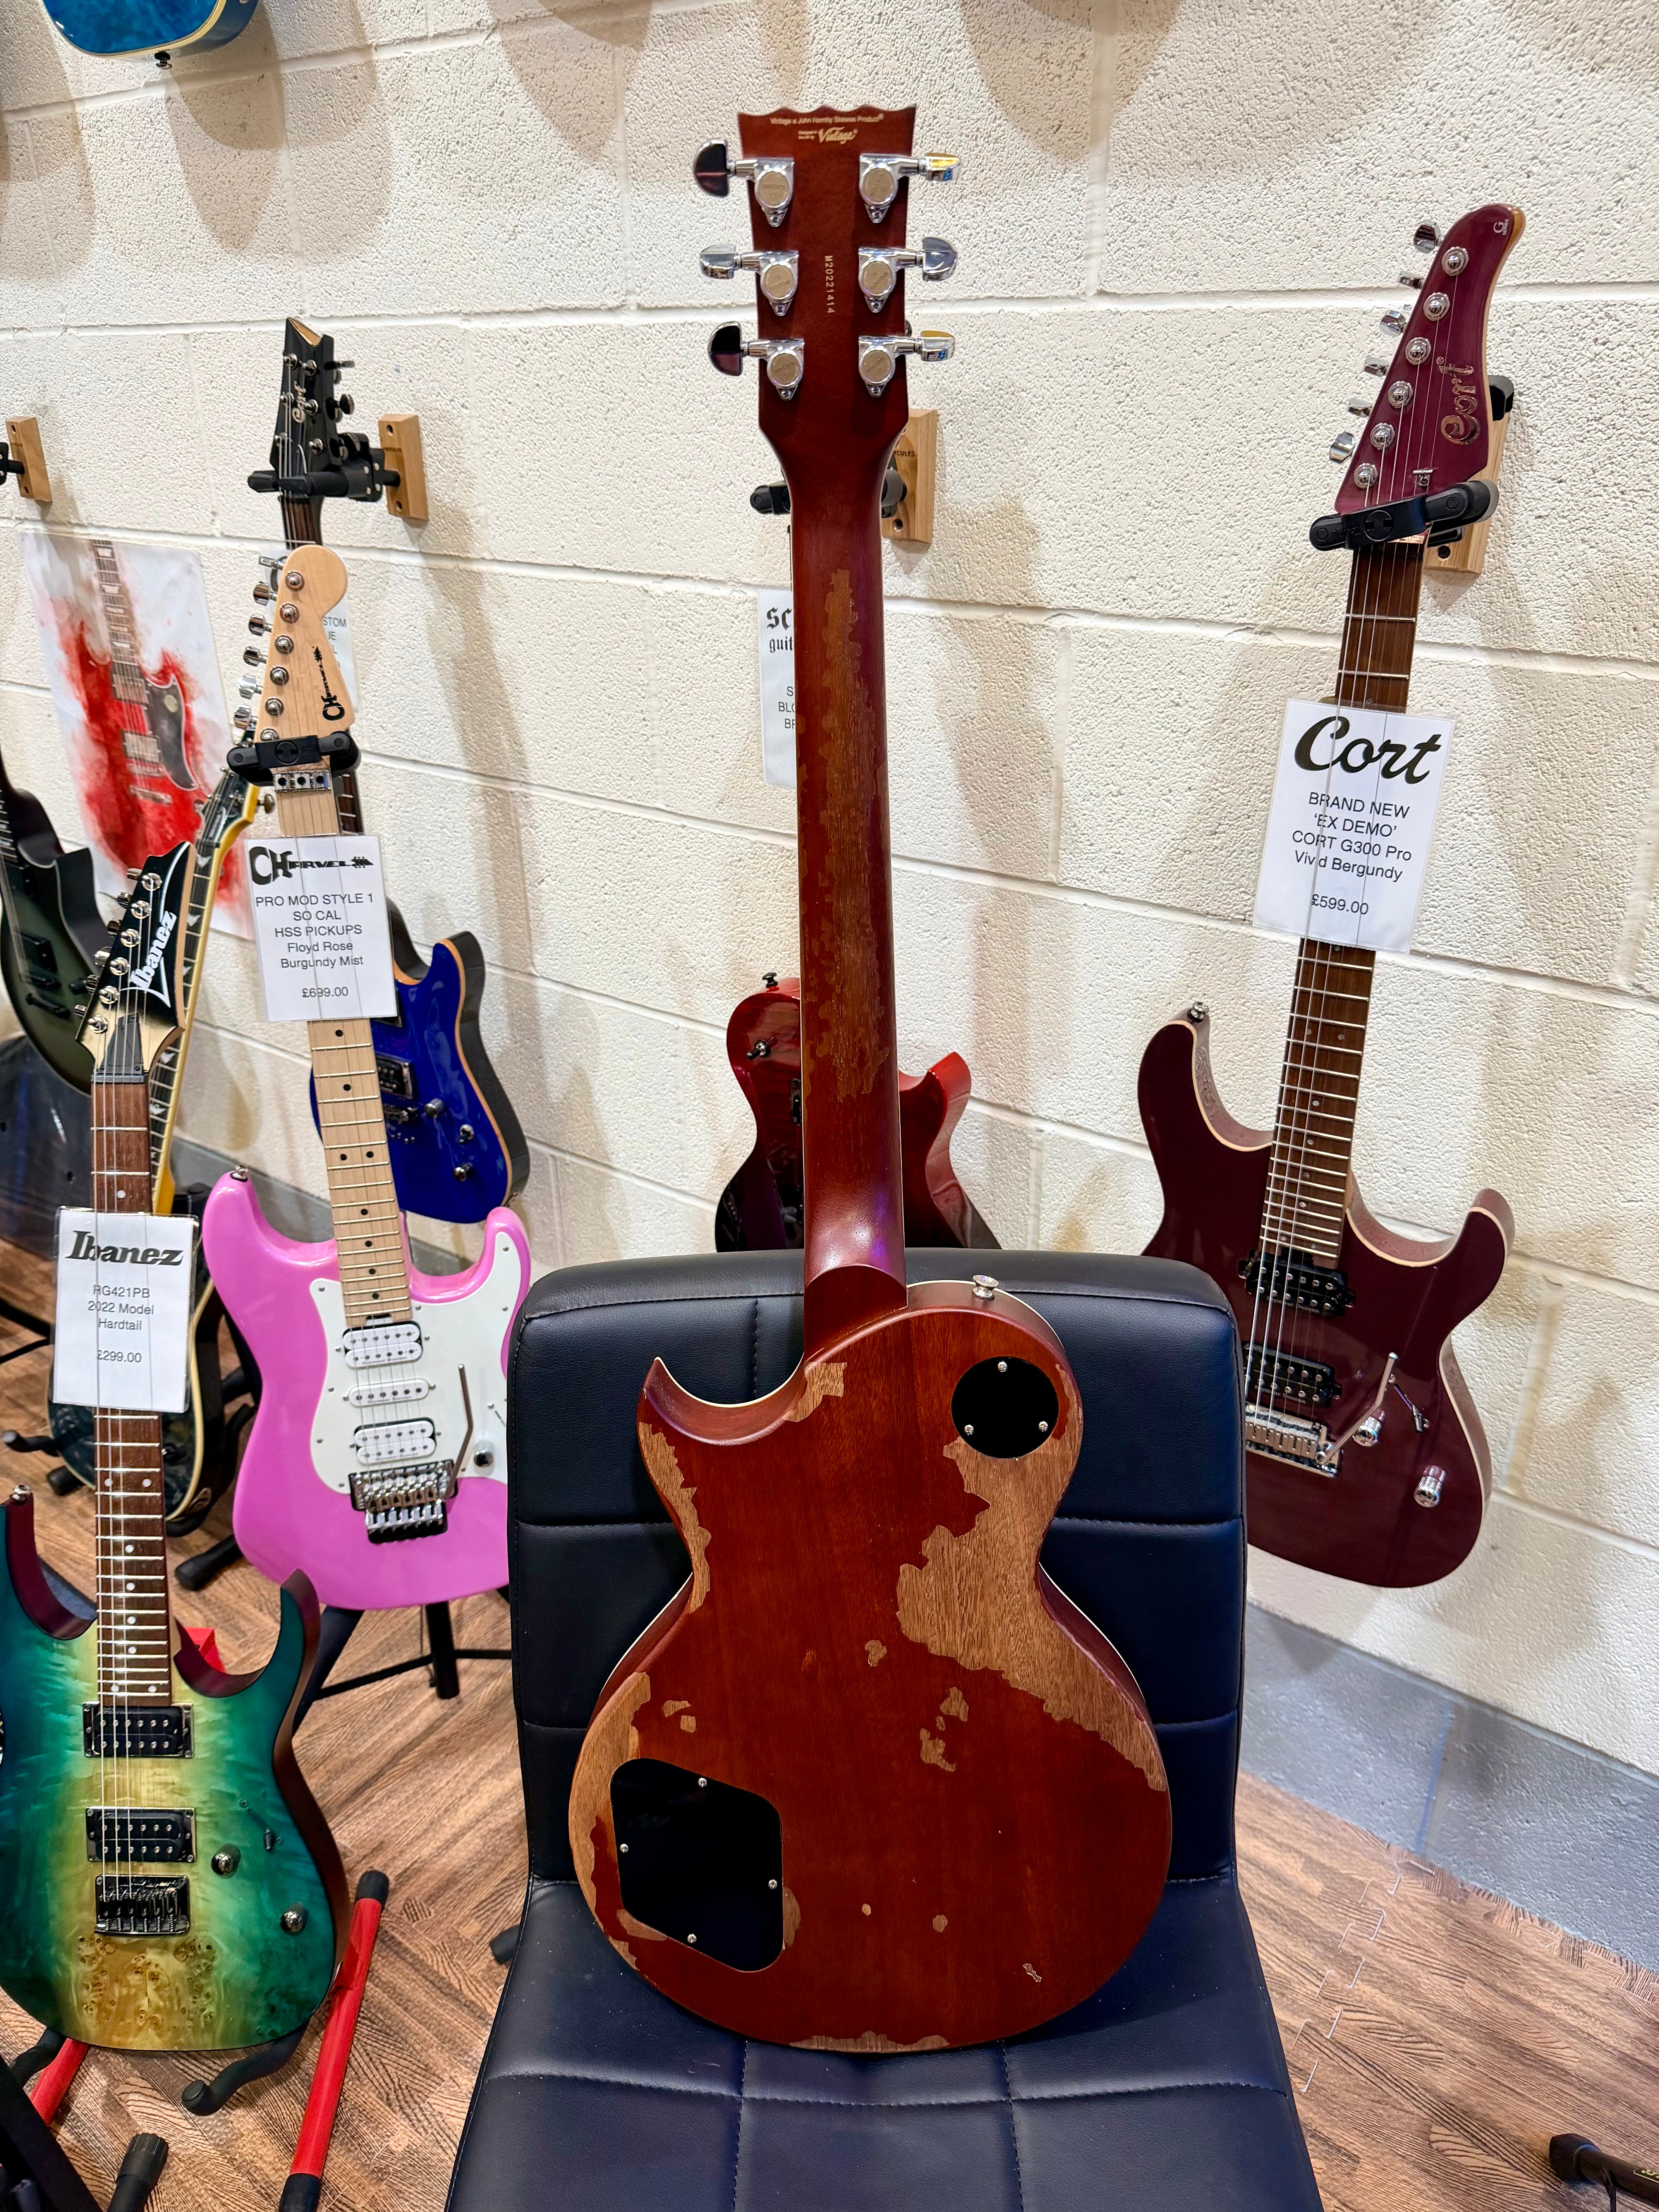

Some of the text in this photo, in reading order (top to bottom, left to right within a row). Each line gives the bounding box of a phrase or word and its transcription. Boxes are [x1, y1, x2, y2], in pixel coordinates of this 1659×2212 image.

[825, 255, 835, 313] M20221414
[322, 617, 347, 628] STOM
[1294, 716, 1442, 785] Cort
[1309, 792, 1410, 819] BRAND NEW
[1292, 830, 1412, 861] CORT G300 Pro
[1295, 850, 1403, 883] Vivd Bergundy
[256, 893, 373, 907] PRO MOD STYLE 1
[1310, 893, 1369, 915] £599.00
[293, 910, 342, 921] SO CAL
[275, 924, 362, 938] HSS PICKUPS
[129, 910, 177, 989] Ibanez
[288, 941, 353, 955] Floyd Rose
[281, 955, 364, 970] Burgundy Mist
[302, 986, 349, 998] £699.00
[65, 1230, 184, 1266] Ibanez
[93, 1284, 150, 1298] RG421PB
[88, 1300, 154, 1315] 2022 Model
[98, 1317, 142, 1331] Hardtail
[96, 1350, 142, 1363] £299.00
